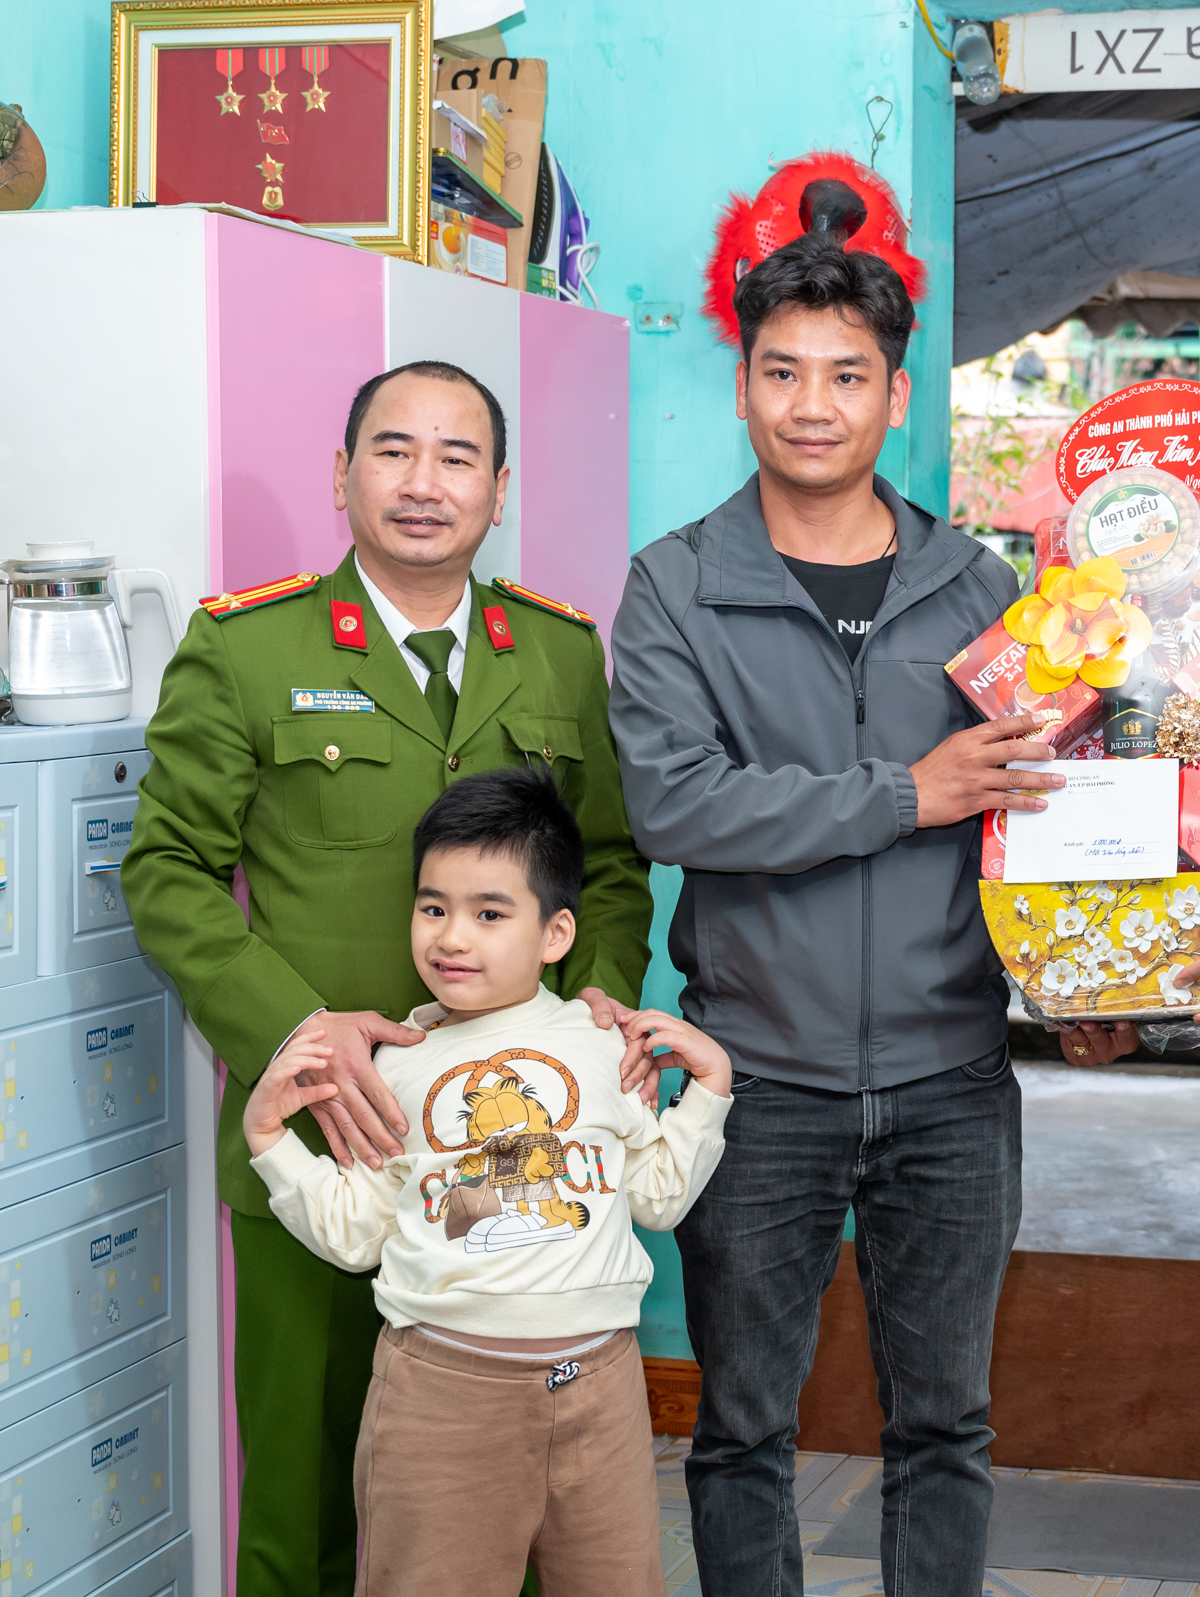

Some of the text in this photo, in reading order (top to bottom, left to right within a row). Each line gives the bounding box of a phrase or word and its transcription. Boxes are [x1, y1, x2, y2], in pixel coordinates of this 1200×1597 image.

[1069, 28, 1164, 76] ZX1
[1088, 421, 1111, 438] CÔNG
[1112, 420, 1124, 434] AN
[1125, 415, 1153, 432] THÀNH
[1154, 409, 1173, 428] PHỐ
[1174, 408, 1190, 426] HẢI
[1075, 444, 1115, 478] Chúc
[1106, 438, 1160, 474] Mừng
[1158, 434, 1195, 464] Năm
[1098, 496, 1159, 529] HẠT ĐIỀU
[316, 690, 341, 699] NGUYỄN
[1110, 740, 1158, 752] JULIO LOPEZ
[88, 821, 108, 839] PANDA
[109, 840, 122, 848] SONG
[87, 1024, 134, 1050] PANDA CABINET
[108, 1046, 121, 1056] SONG
[121, 1042, 134, 1052] LONG
[91, 1227, 138, 1259] PANDA CABINET
[112, 1251, 124, 1262] SONG
[124, 1246, 137, 1256] LONG
[92, 1427, 140, 1465] PANDA CABINET
[113, 1453, 126, 1464] SONG
[126, 1446, 138, 1458] LONG
